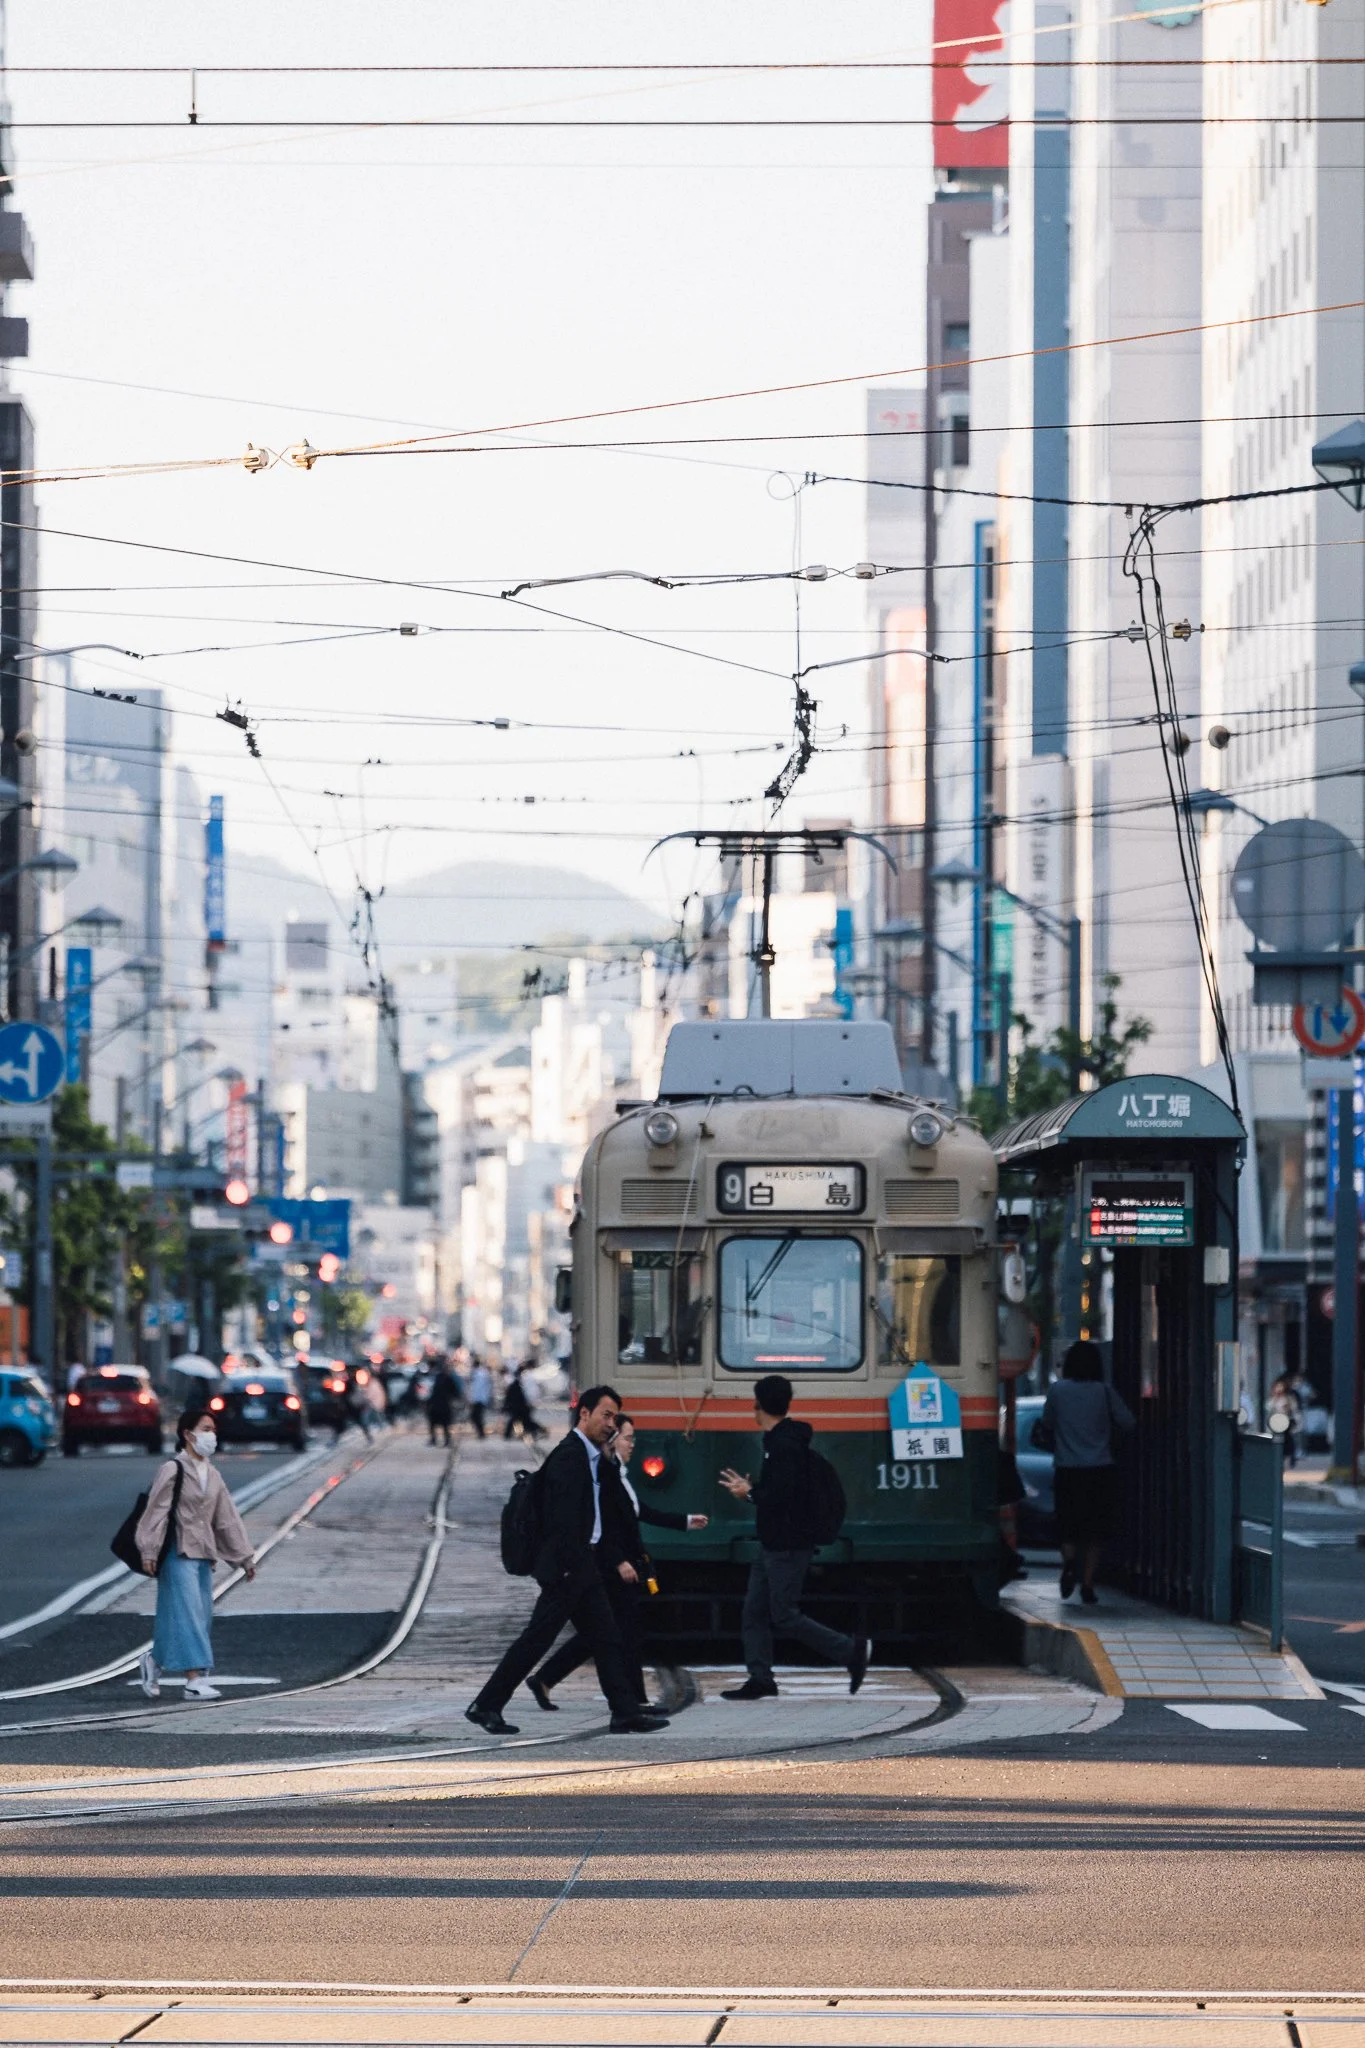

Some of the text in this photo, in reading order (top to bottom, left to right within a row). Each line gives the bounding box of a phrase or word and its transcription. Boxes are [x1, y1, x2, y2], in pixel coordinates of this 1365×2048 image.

[1117, 1093, 1191, 1117] 八丁堀
[1126, 1119, 1183, 1128] HATCHOBORI
[765, 1171, 834, 1180] HAKUSHIMA
[725, 1174, 741, 1204] 9
[749, 1181, 852, 1206] 白島
[877, 1463, 939, 1490] 1911
